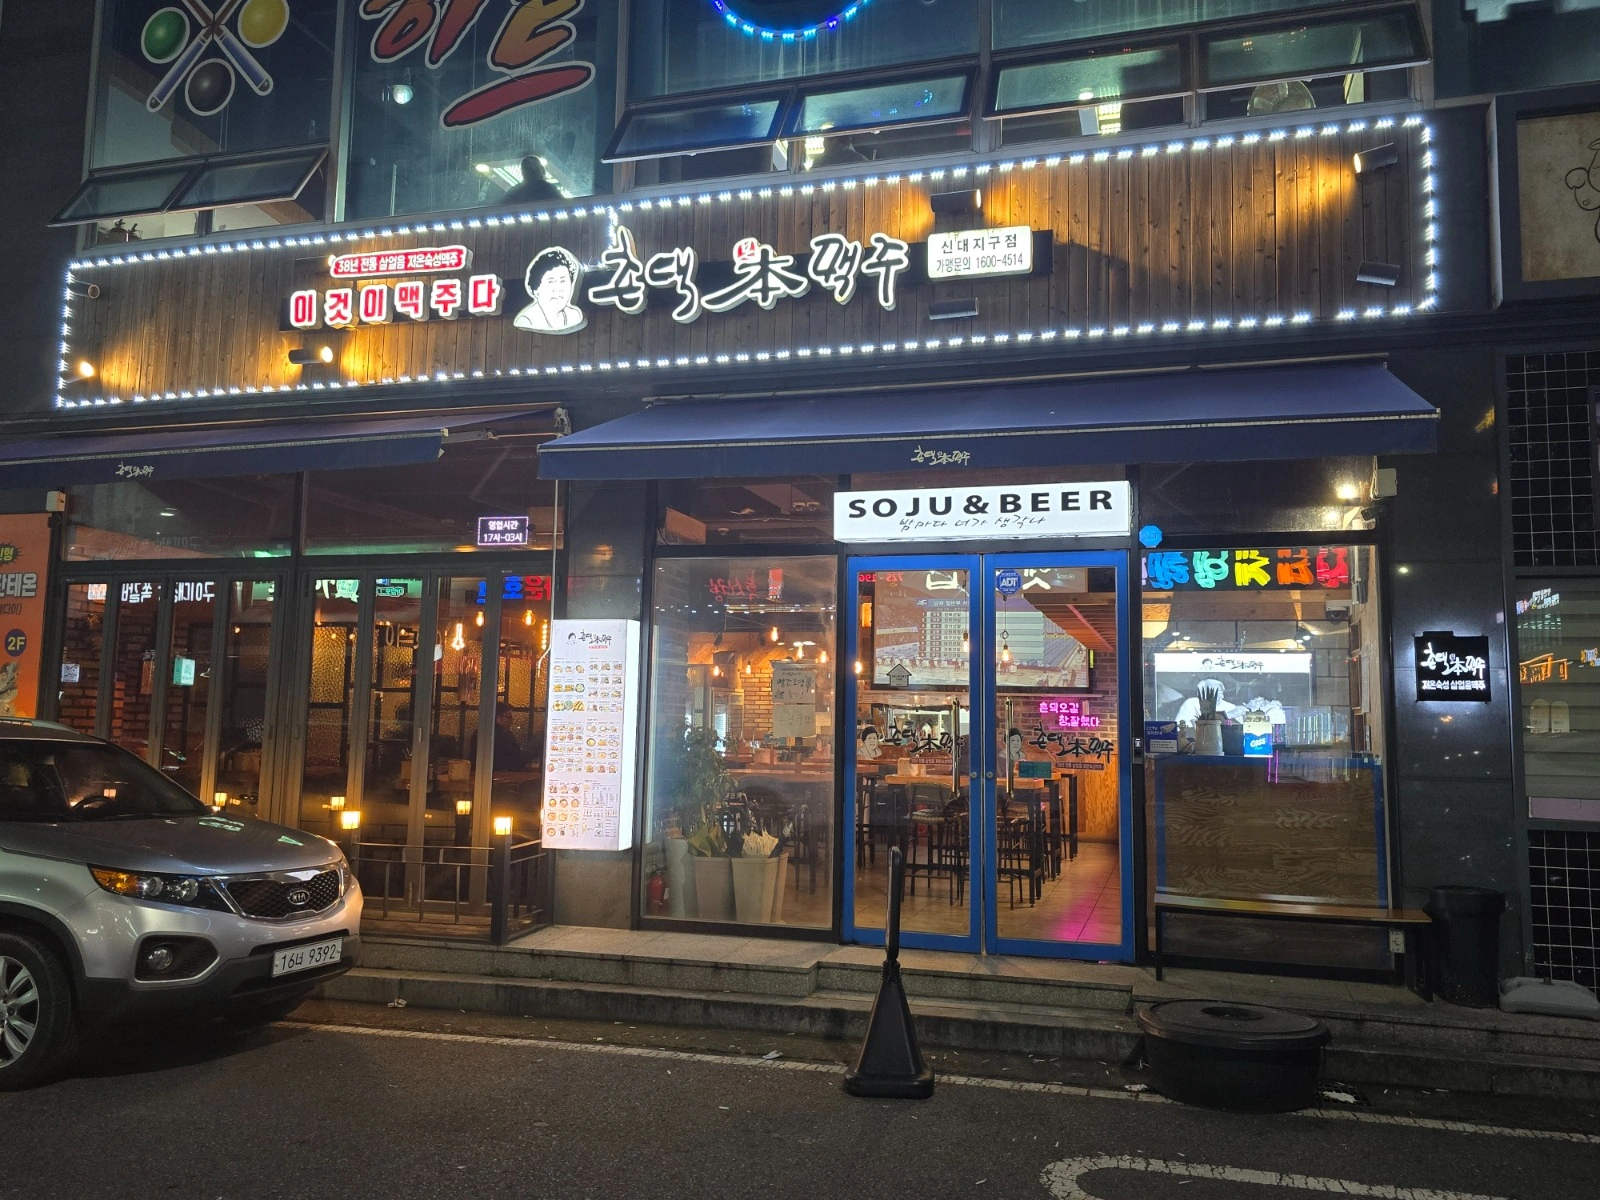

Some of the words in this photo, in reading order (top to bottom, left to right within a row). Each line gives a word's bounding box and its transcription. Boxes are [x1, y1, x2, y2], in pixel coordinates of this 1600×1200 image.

[941, 233, 1017, 254] 신대지구점
[337, 258, 359, 273] 38년
[360, 256, 377, 272] 전통
[379, 254, 405, 270] 살얼음
[407, 251, 459, 268] 저온숙성맥주
[936, 256, 971, 273] 가맹문의
[976, 252, 1023, 269] 1600-4514
[488, 520, 519, 530] 영업시간
[899, 518, 948, 533] 밤마다
[955, 516, 988, 528] 너가
[994, 514, 1047, 530] 생각나
[1000, 577, 1018, 587] ADT
[7, 636, 26, 651] 2F
[292, 892, 306, 902] KIA
[281, 951, 304, 971] 16너
[308, 943, 337, 965] 9392
